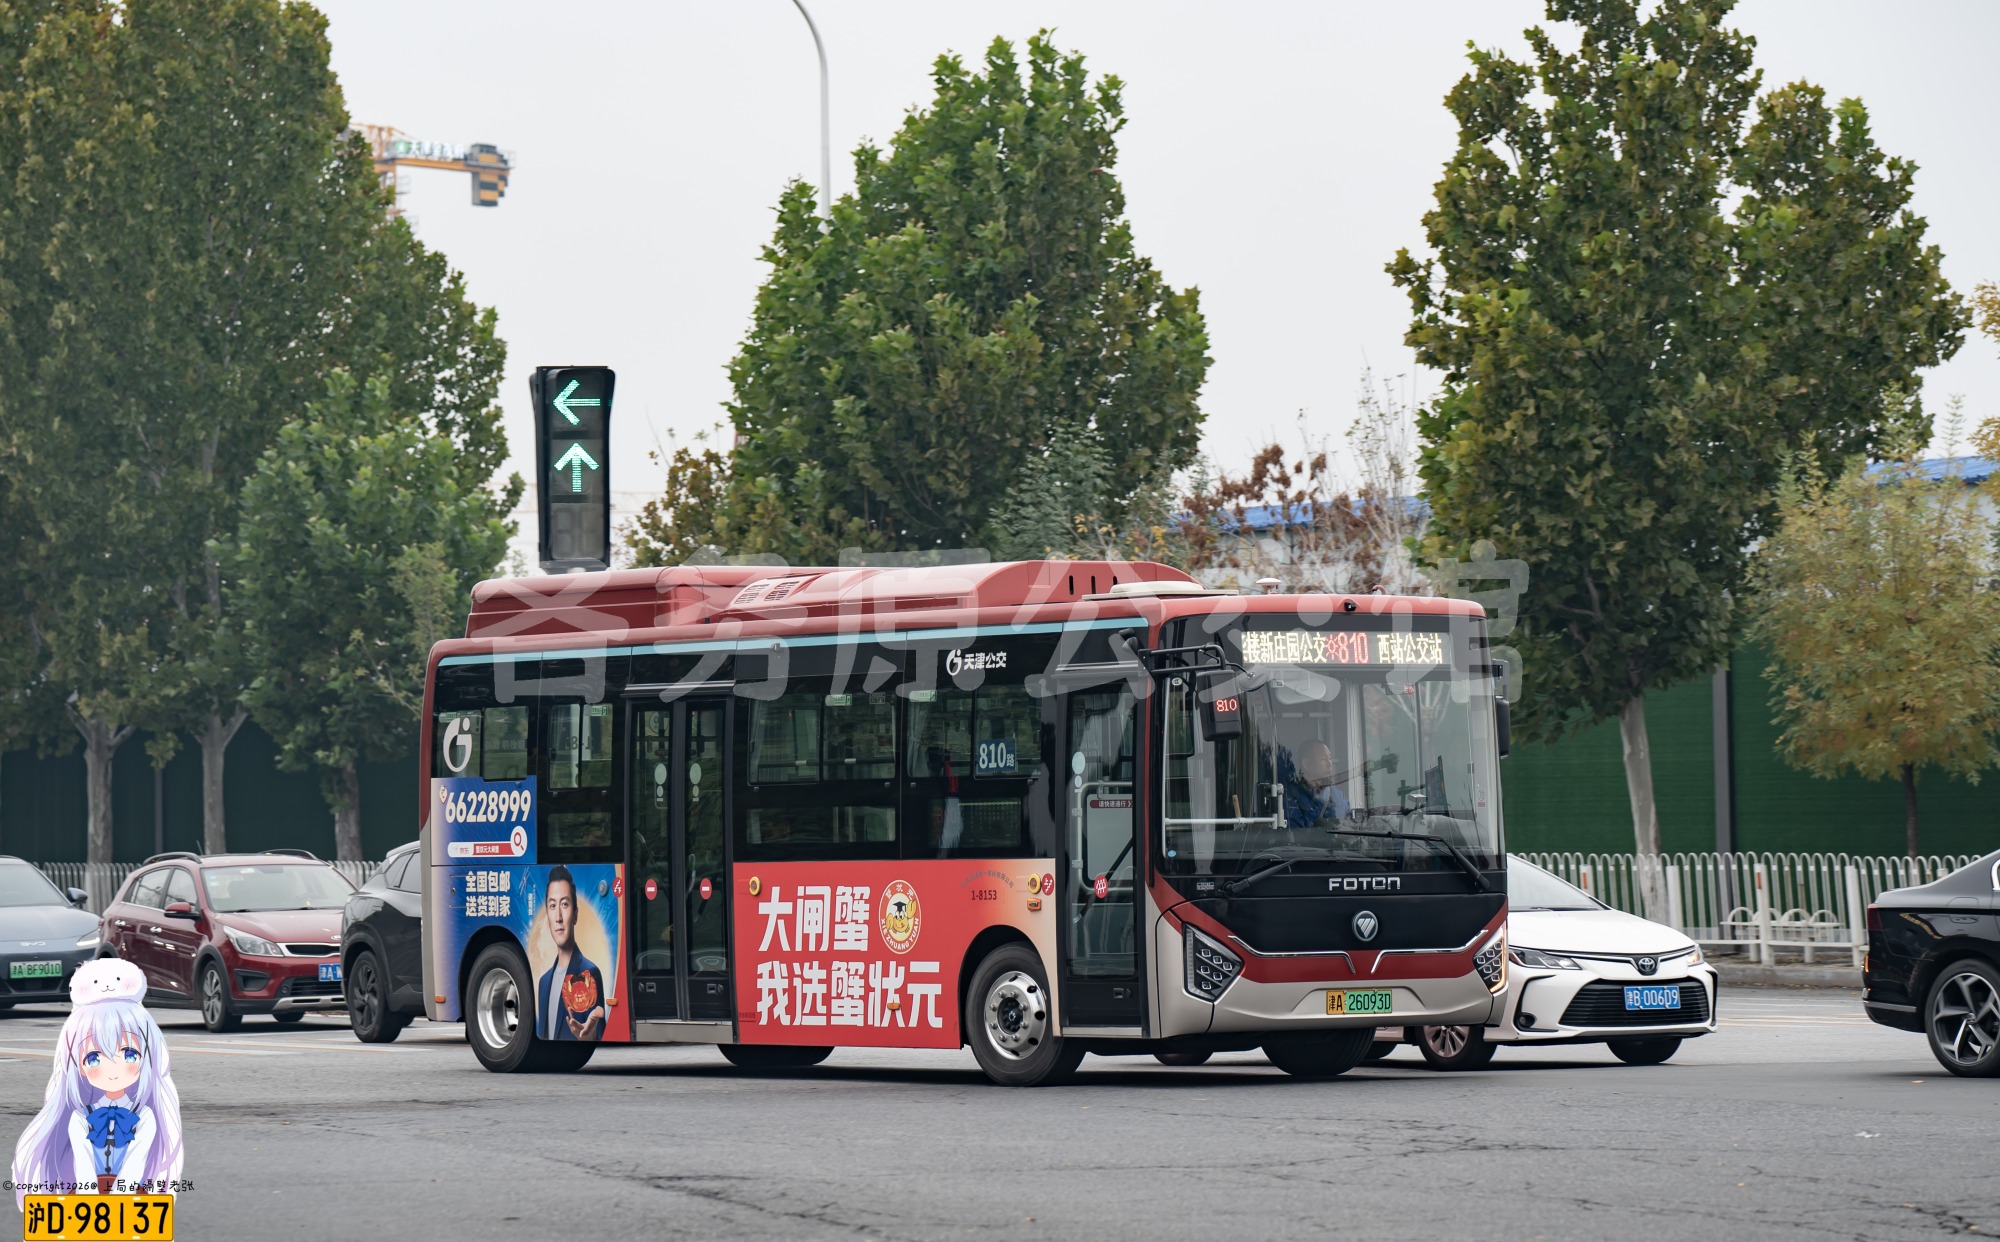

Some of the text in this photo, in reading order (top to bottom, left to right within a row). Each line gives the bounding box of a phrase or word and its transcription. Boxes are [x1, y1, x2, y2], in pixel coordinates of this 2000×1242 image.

[1241, 631, 1443, 664] 楼新庄园公交 810 西站公交站
[963, 651, 1007, 670] 天津公交
[1216, 699, 1238, 712] 810
[445, 789, 532, 824] 66228999
[465, 871, 511, 893] 全国包邮
[1328, 877, 1401, 891] FOTON
[971, 889, 997, 901] 1-8153
[465, 896, 511, 918] 送货到家
[758, 886, 870, 952] 大闸蟹
[886, 934, 910, 951] ZHUANG
[909, 917, 919, 942] YUAN
[757, 960, 943, 1028] 我选蟹状元
